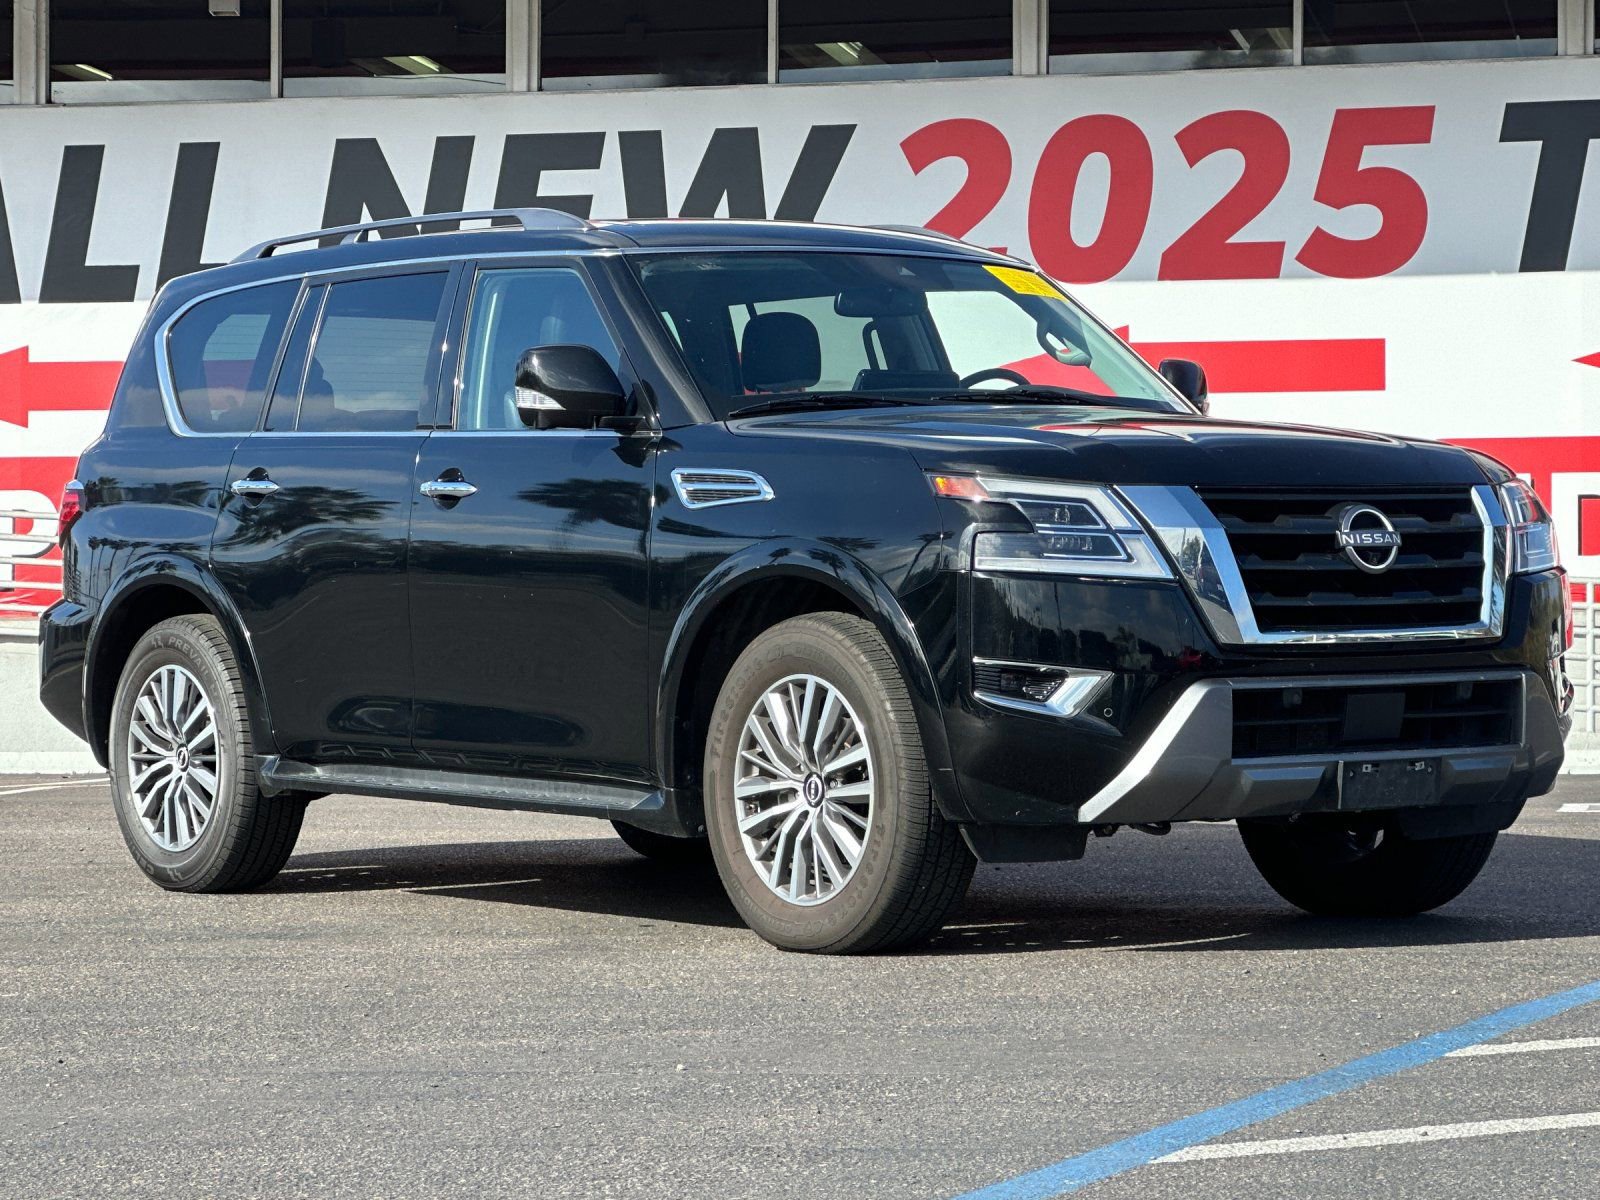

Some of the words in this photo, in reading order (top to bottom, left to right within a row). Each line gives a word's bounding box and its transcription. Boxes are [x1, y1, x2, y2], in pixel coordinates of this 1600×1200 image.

[0, 141, 227, 304] LL
[318, 124, 857, 248] NEW
[900, 105, 1435, 285] 2025
[1341, 533, 1401, 544] NISSAN
[168, 636, 210, 677] PREVAIL
